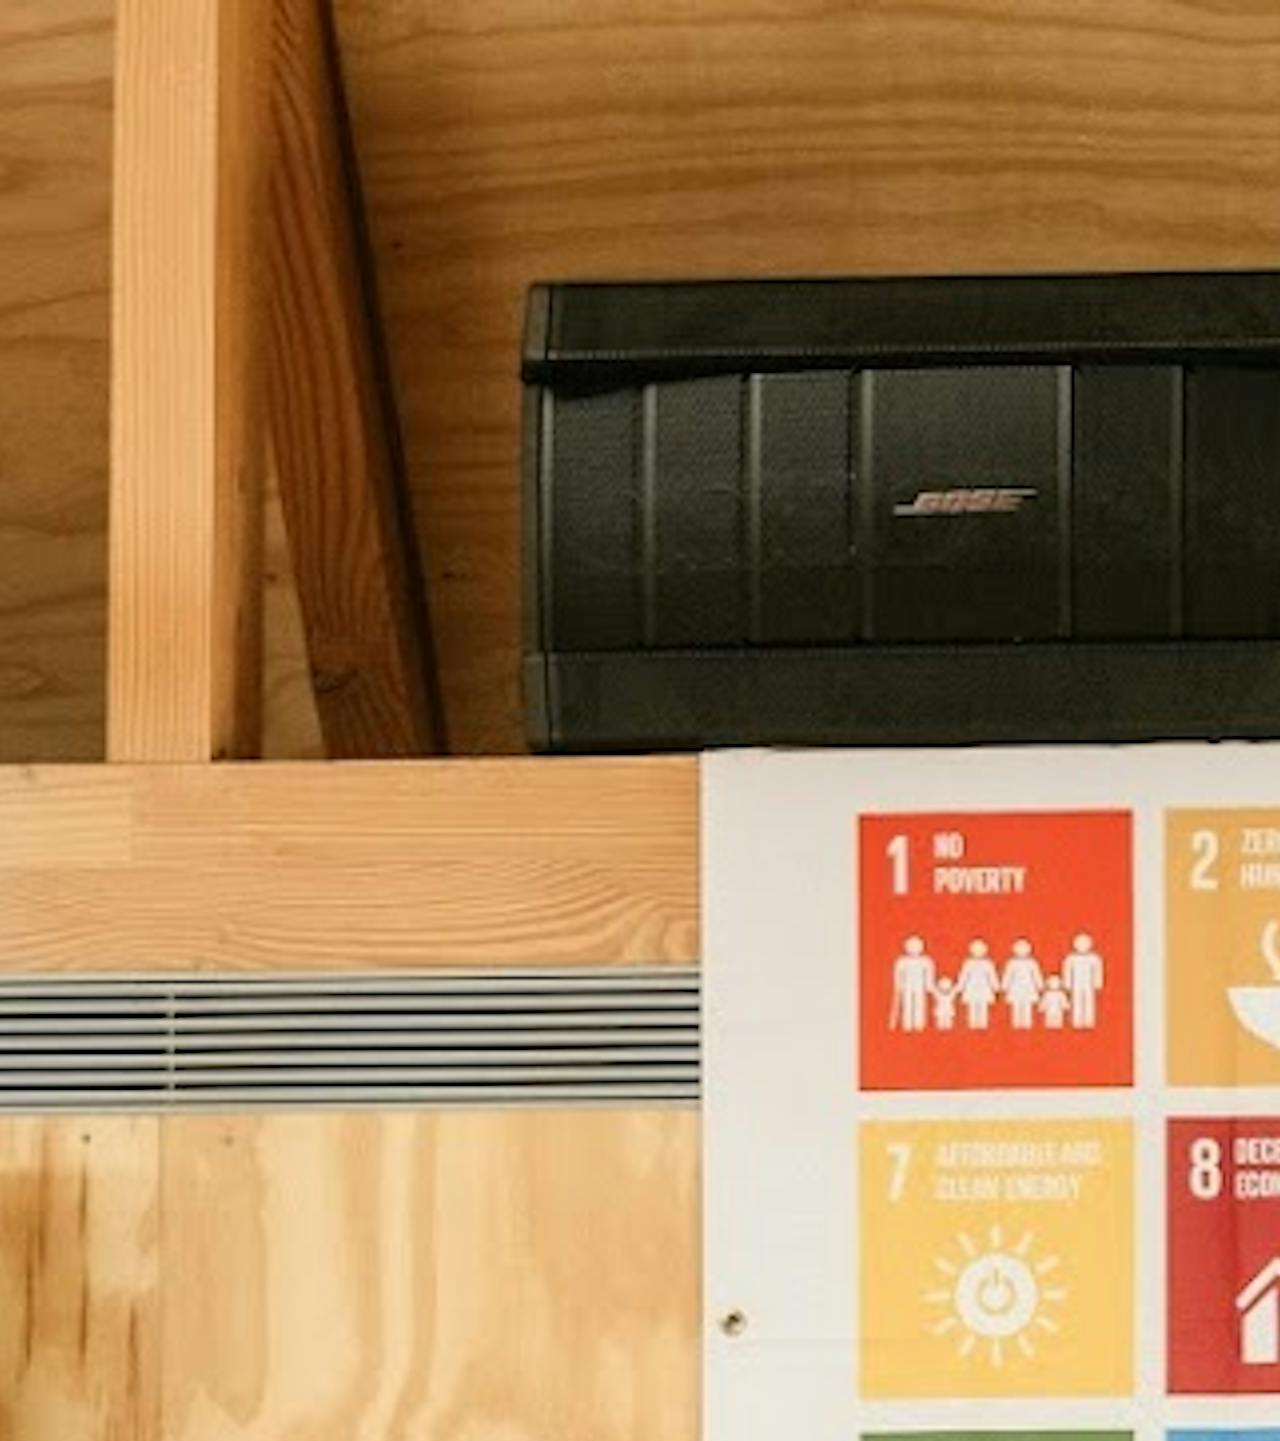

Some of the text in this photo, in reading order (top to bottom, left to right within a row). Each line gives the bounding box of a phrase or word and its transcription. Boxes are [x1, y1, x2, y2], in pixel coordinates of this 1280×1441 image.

[886, 834, 910, 895] 1
[933, 831, 965, 859] NO
[1191, 828, 1219, 891] 2
[933, 865, 1026, 894] POVERTY
[885, 1144, 913, 1203] 7
[1188, 1137, 1222, 1198] 8
